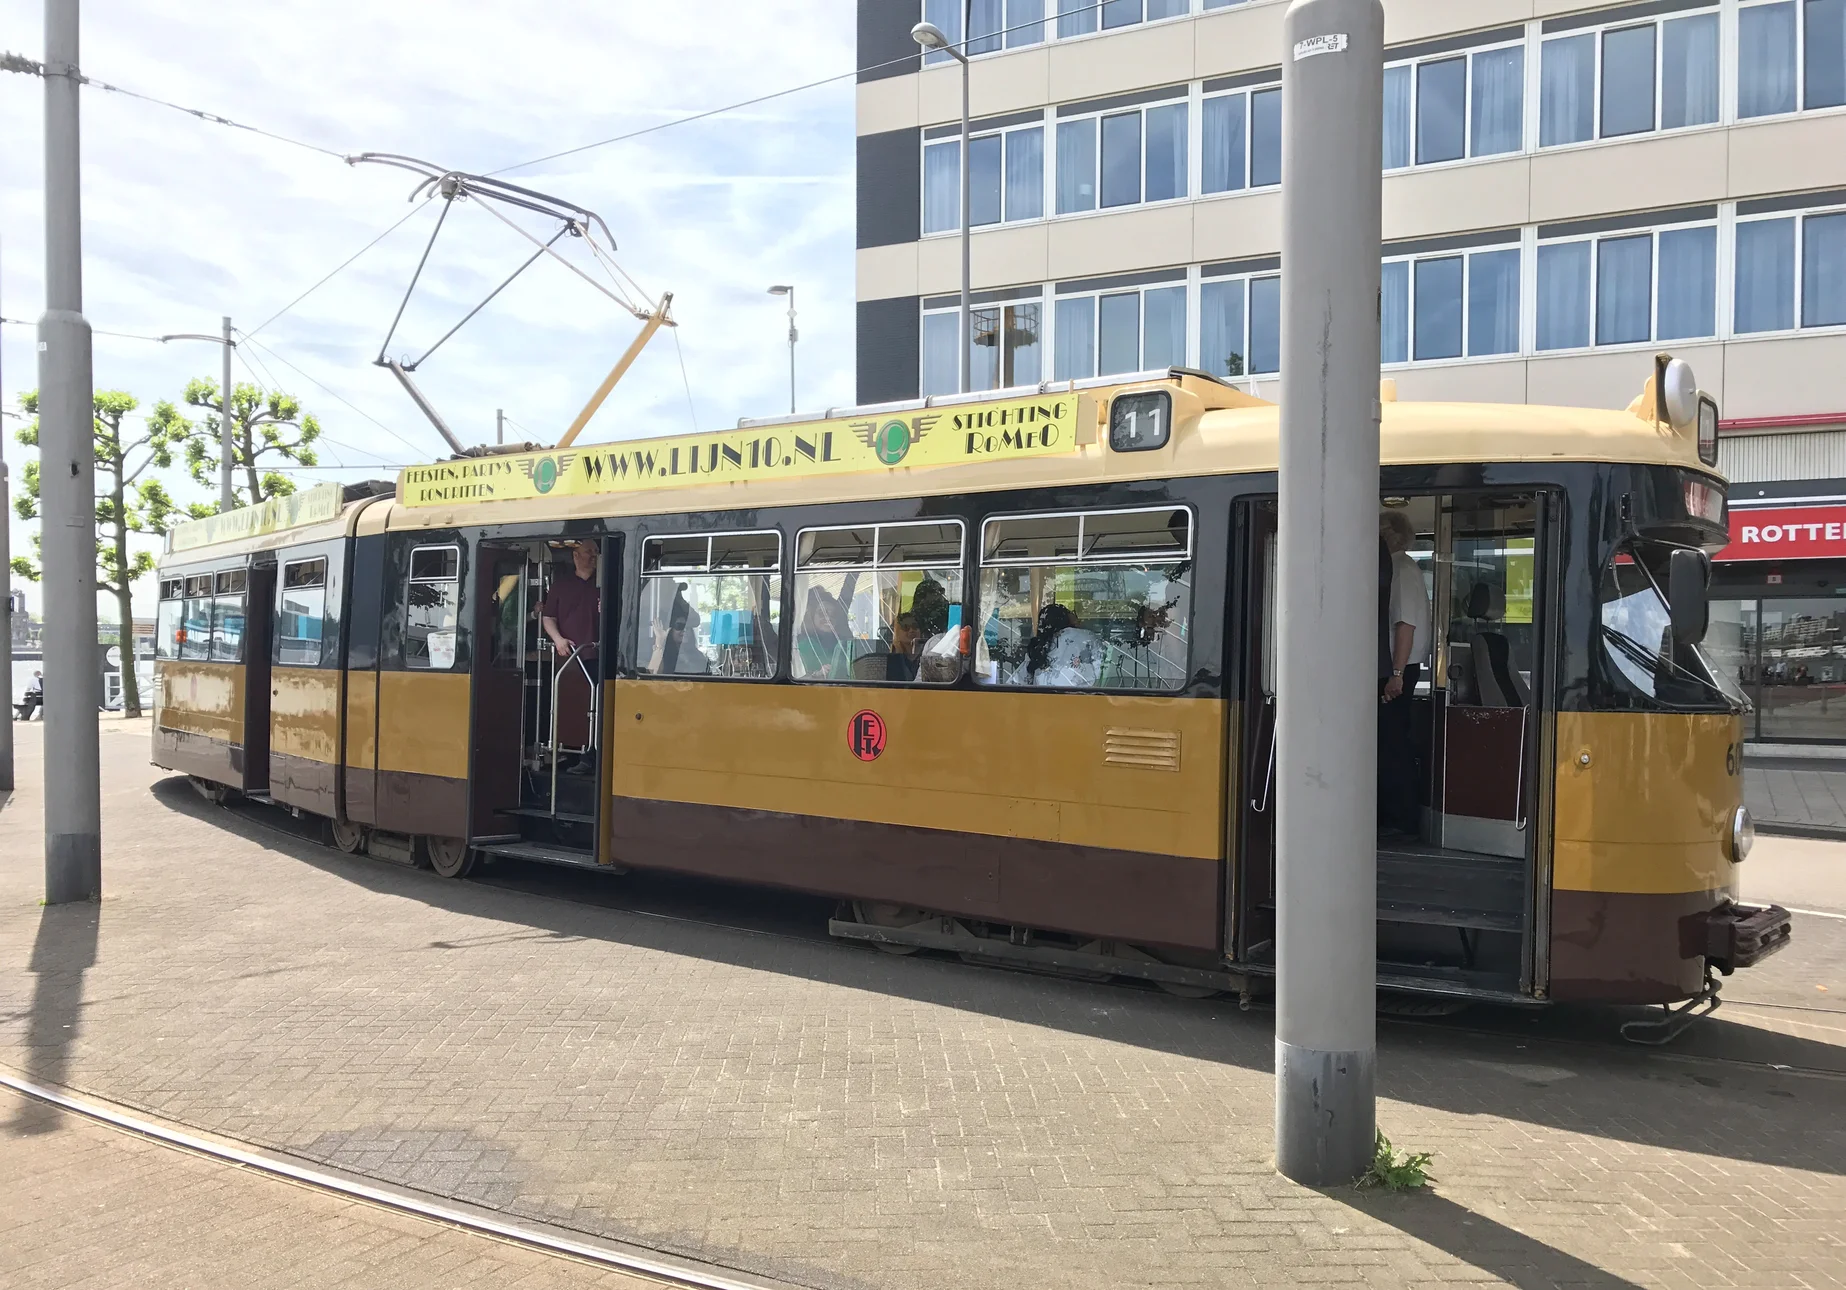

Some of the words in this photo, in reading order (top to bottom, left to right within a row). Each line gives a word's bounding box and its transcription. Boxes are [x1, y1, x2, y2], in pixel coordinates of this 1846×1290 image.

[952, 401, 1067, 431] STICHTING
[1124, 407, 1162, 438] 11
[407, 466, 459, 484] FEESTEN,
[463, 460, 512, 478] PARTY'S
[584, 431, 842, 484] WWW.LIJN10.NL
[420, 483, 494, 502] RONDRITTEN
